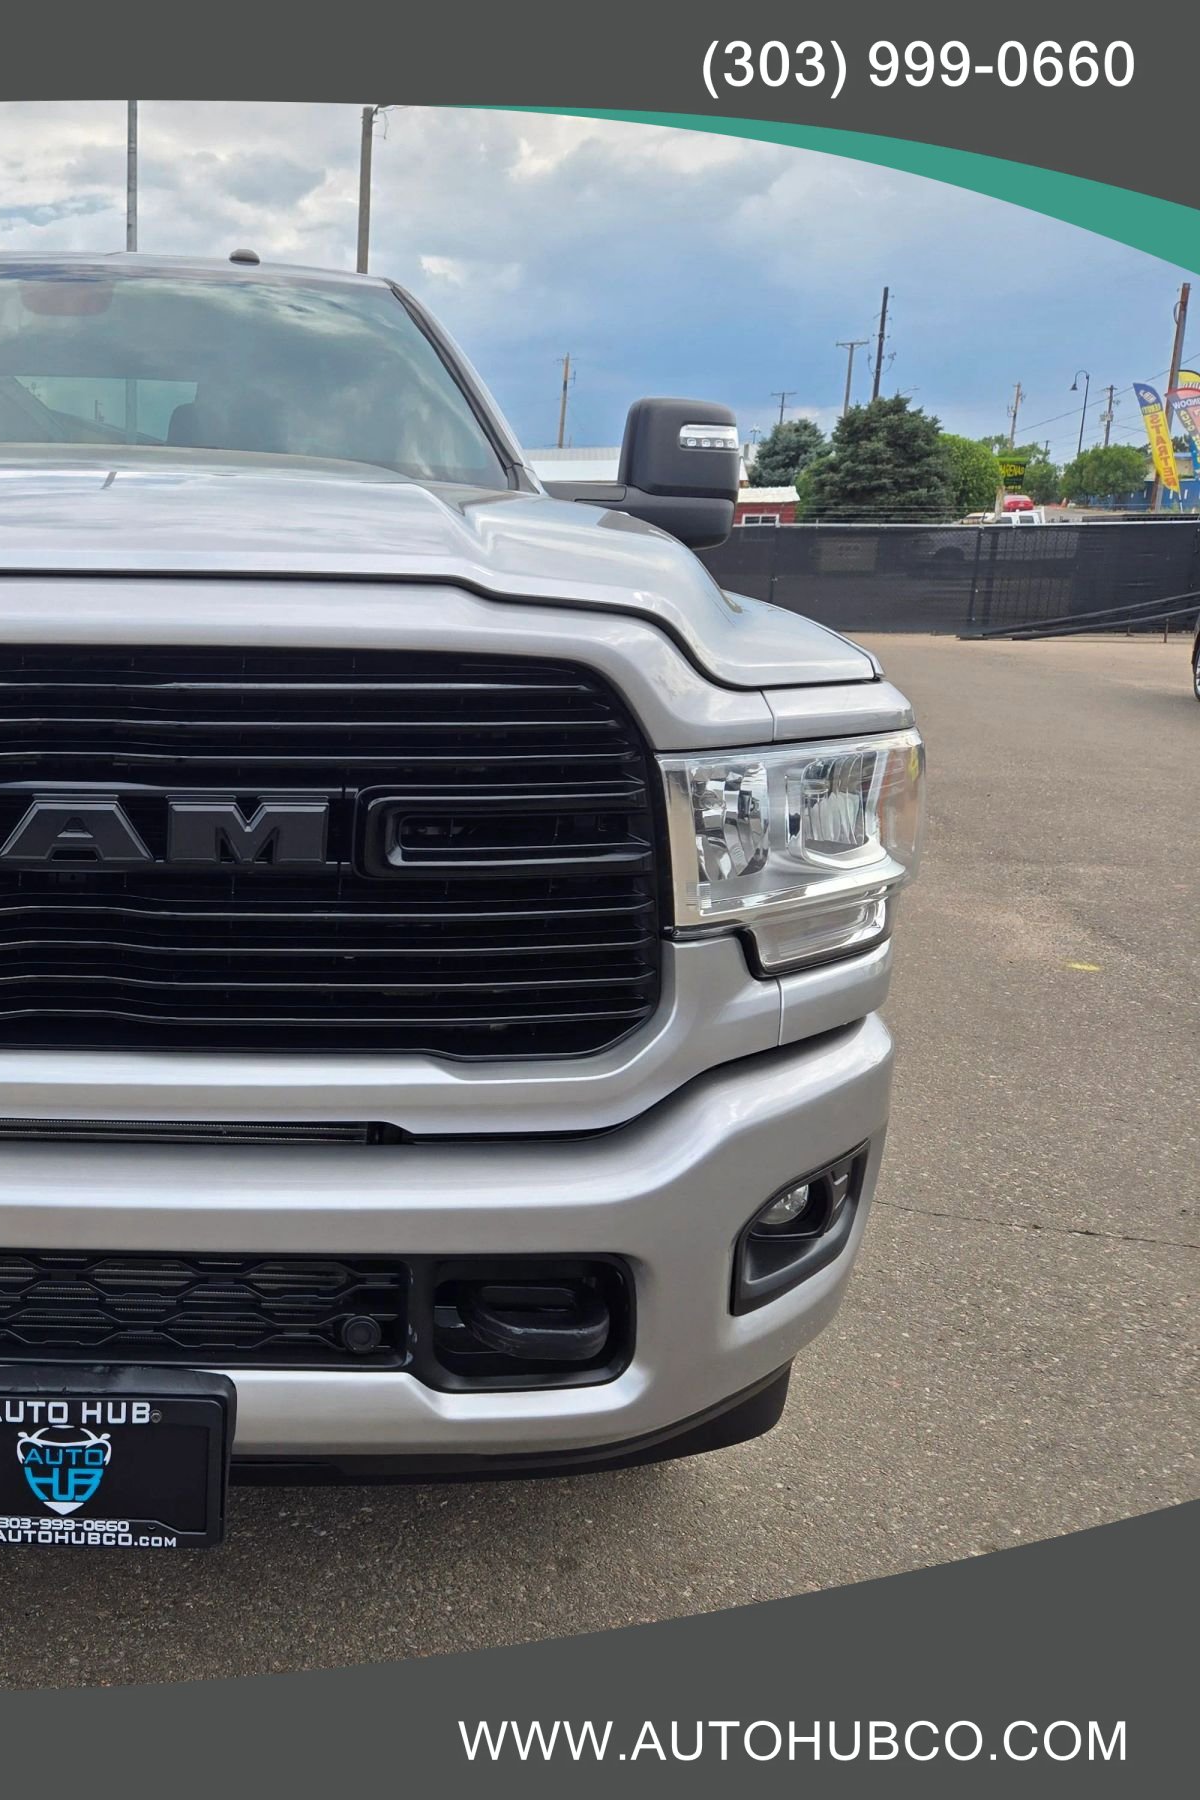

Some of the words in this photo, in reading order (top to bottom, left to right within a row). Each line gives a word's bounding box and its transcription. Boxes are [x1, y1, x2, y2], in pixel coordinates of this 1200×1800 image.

[81, 1401, 151, 1424] HUB
[24, 1449, 103, 1465] AUTO
[24, 1467, 104, 1501] HUB
